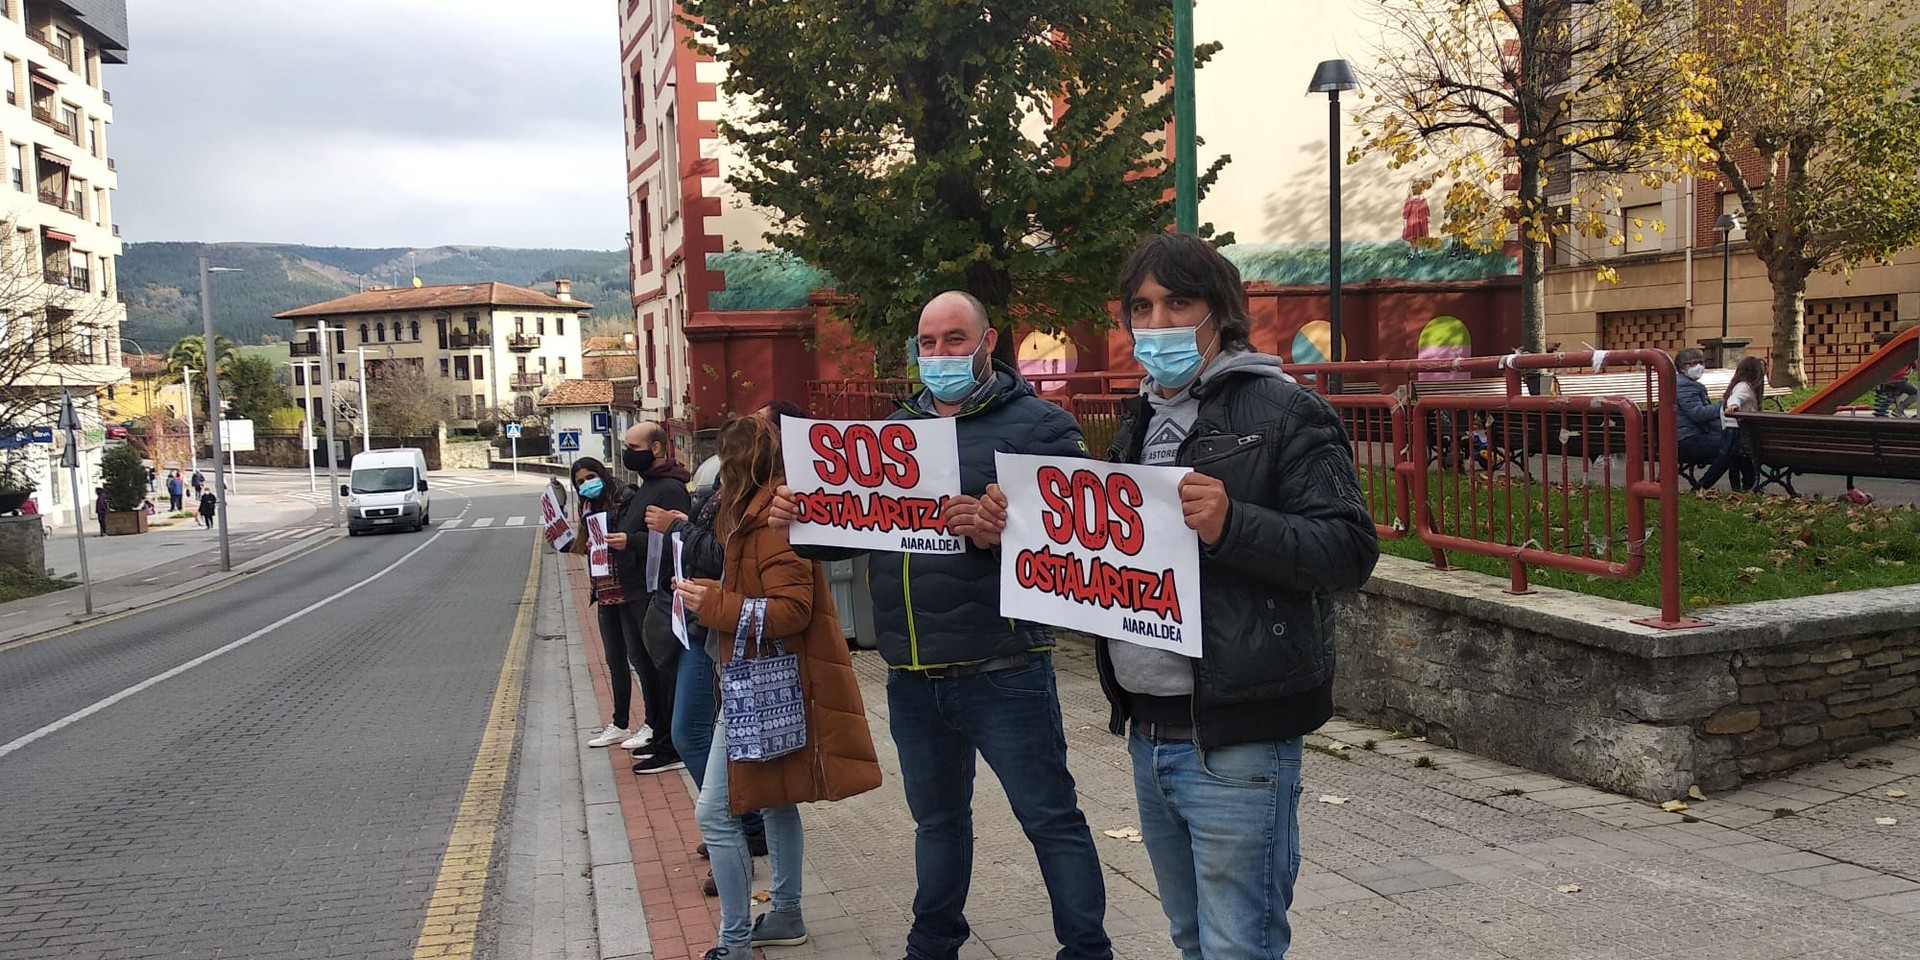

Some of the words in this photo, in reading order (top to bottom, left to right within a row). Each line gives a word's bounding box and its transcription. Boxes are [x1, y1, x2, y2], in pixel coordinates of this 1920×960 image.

[595, 415, 606, 430] L
[809, 423, 920, 489] SOS
[1037, 466, 1144, 556] SOS
[900, 537, 961, 551] AIARALDEA
[1016, 545, 1183, 624] OSTALARITZA
[1122, 617, 1183, 643] AIARALDEA
